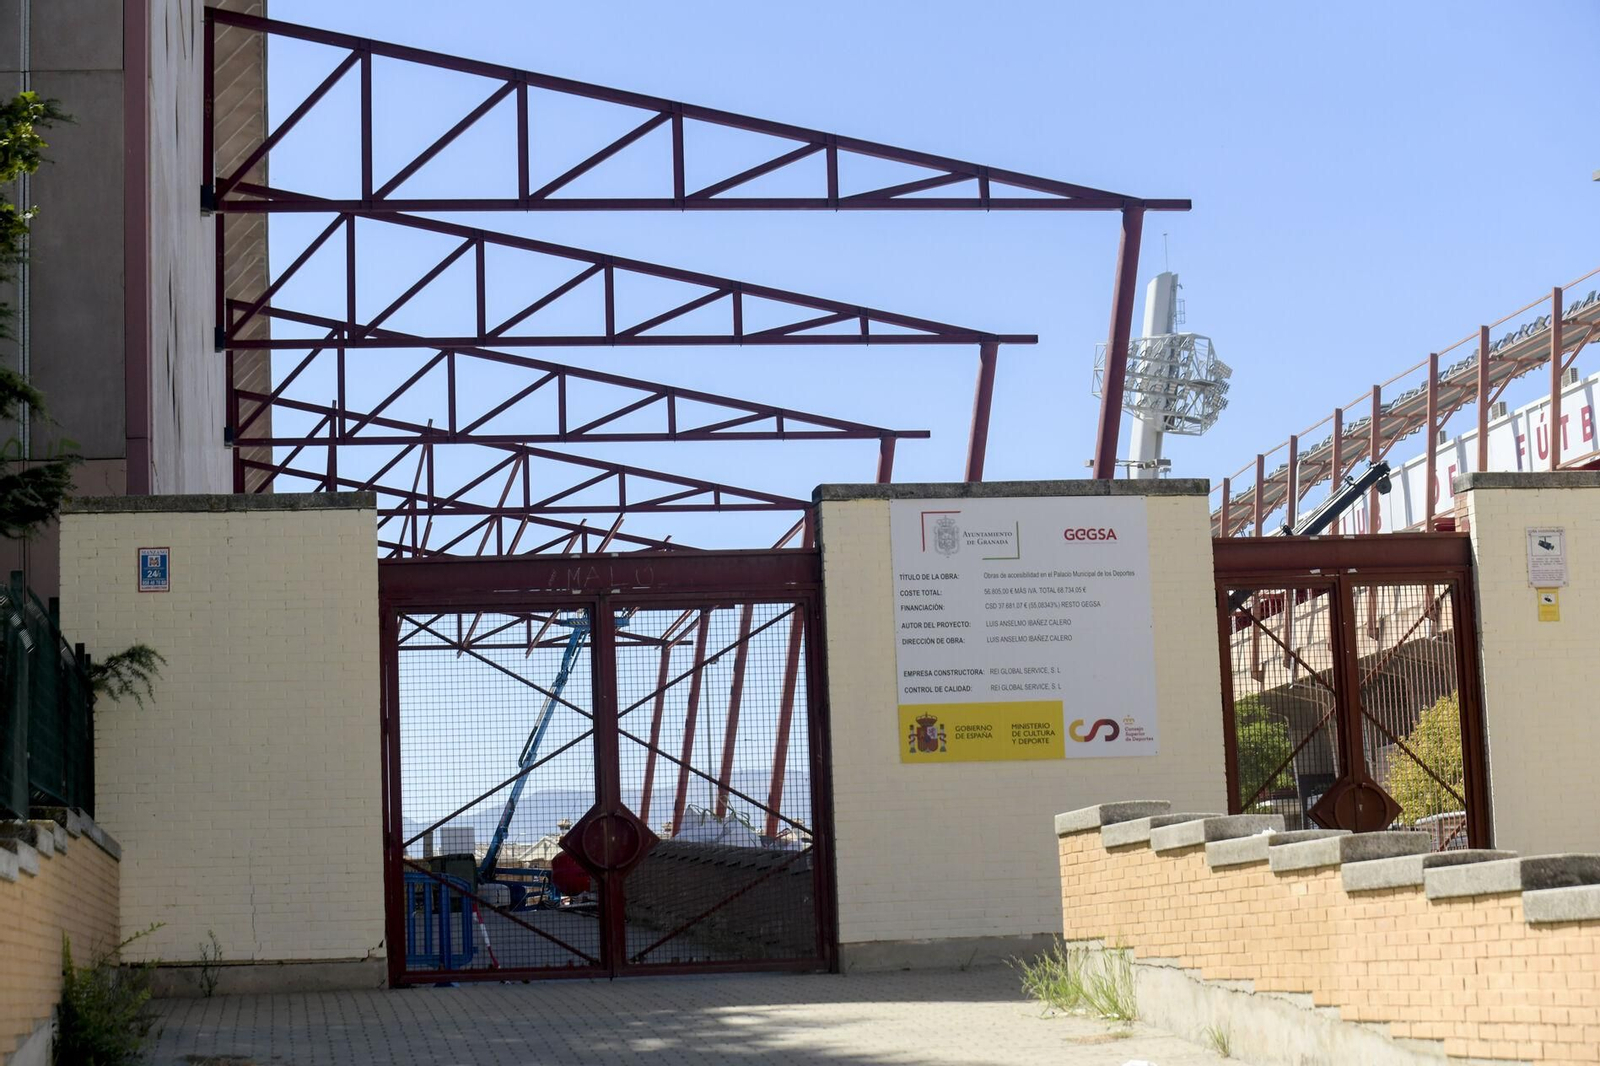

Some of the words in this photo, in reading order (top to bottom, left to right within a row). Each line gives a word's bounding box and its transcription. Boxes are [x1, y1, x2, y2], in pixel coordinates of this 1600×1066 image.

[899, 573, 920, 581] TÍTULO
[1073, 570, 1097, 578] Municipal
[899, 589, 921, 597] COSTE
[900, 603, 945, 611] FINANCIACIÓN:
[923, 621, 936, 629] DEL
[999, 619, 1026, 627] ANSELMO
[945, 637, 966, 645] OBRA:
[1000, 635, 1028, 643] ANSELMO
[1000, 667, 1023, 675] GLOBAL
[1001, 683, 1024, 691] GLOBAL
[966, 731, 993, 740] ESPAÑA
